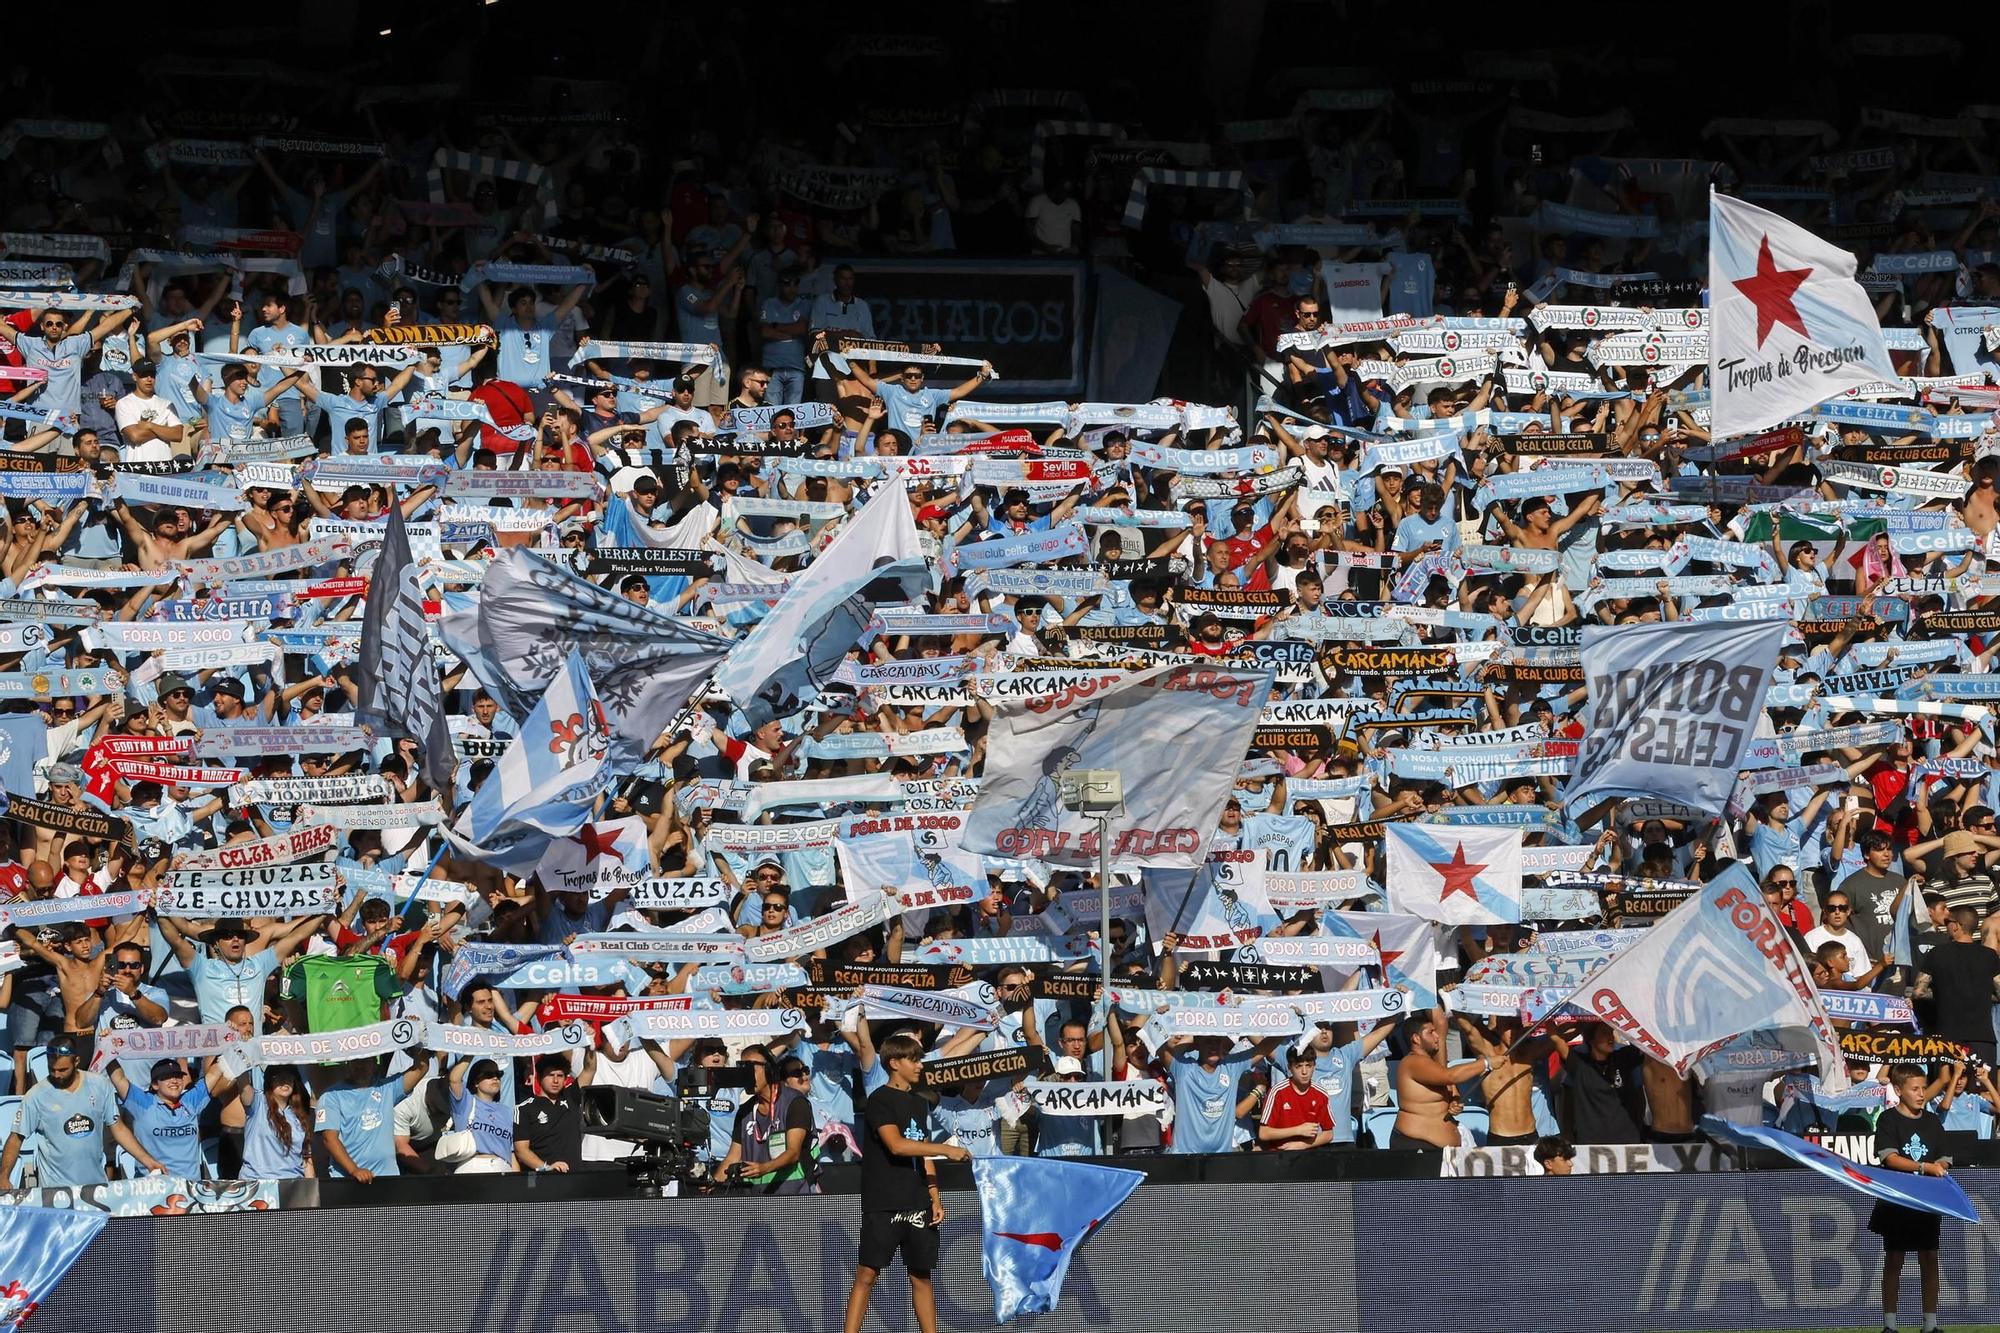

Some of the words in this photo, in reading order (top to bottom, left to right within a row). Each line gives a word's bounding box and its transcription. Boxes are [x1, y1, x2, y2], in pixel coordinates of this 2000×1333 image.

[1877, 254, 1954, 271] RCCelta
[1718, 358, 1773, 392] Tropas
[1778, 354, 1793, 375] de
[1793, 339, 1866, 374] Breogán
[1830, 404, 1855, 418] R.C.
[1857, 406, 1898, 421] CELTA
[1379, 443, 1396, 463] RC
[1399, 440, 1444, 460] CELTA
[1516, 440, 1540, 451] REAL
[1542, 439, 1565, 450] CLUB
[1567, 438, 1593, 450] CELTA
[1866, 449, 1892, 461] REAL
[1894, 449, 1922, 460] CLUB
[1924, 448, 1950, 460] CELTA
[10, 460, 43, 472] CELTA
[1043, 462, 1076, 472] Sevilla
[140, 481, 158, 493] REAL
[160, 484, 182, 498] CLUB
[183, 485, 208, 500] CELTA
[1899, 474, 1965, 492] CELESTE
[224, 547, 304, 576] CELTA
[598, 548, 640, 560] TERRA
[644, 550, 701, 561] CELESTE
[1511, 550, 1553, 566] ASPAS
[1881, 577, 1946, 595] CELTA
[1184, 589, 1212, 602] REAL
[1216, 591, 1245, 604] CLUB
[1247, 592, 1280, 604] CELTA
[218, 601, 272, 619] CELTA
[1694, 602, 1780, 621] RCCelta
[692, 621, 714, 632] Vigo
[1925, 617, 1950, 630] REAL
[1951, 616, 1976, 629] CLUB
[168, 630, 185, 642] DE
[193, 628, 231, 642] XOGO
[1081, 628, 1106, 639] REAL
[1109, 628, 1134, 638] CLUB
[1137, 626, 1165, 638] CELTA
[1334, 649, 1448, 669] CARCAMÄNS
[1516, 667, 1540, 680] REAL
[1542, 667, 1568, 680] CLUB
[1256, 733, 1285, 747] CLUB
[1287, 733, 1320, 747] CELTA
[1409, 753, 1438, 763] NOSA
[1441, 753, 1510, 764] RECONQUISTA
[117, 760, 154, 776] CONTRA
[158, 765, 188, 780] VENTO
[10, 803, 34, 822] REAL
[38, 813, 72, 828] CLUB
[75, 818, 108, 834] CELTA
[893, 817, 914, 832] DE
[917, 815, 961, 831] XOGO
[1458, 813, 1488, 825] R.C.
[1489, 811, 1532, 824] CELTA
[759, 829, 785, 843] DE
[1334, 826, 1360, 840] REAL
[1540, 851, 1558, 866] DE
[174, 863, 330, 887] LE-CHUZAS
[556, 870, 597, 888] Tropas
[601, 867, 612, 882] de
[1301, 879, 1316, 892] DE
[1320, 876, 1356, 891] XOGO
[176, 890, 321, 908] LE-CHUZAS
[916, 892, 936, 906] DE
[939, 885, 973, 902] VIGO
[1625, 900, 1654, 915] REAL
[745, 965, 800, 981] ASPAS
[835, 970, 865, 984] REAL
[1044, 981, 1072, 996] REAL
[1306, 1000, 1324, 1015] DE
[1328, 997, 1371, 1014] XOGO
[1820, 998, 1880, 1016] CELTA
[700, 1016, 718, 1029] DE
[727, 1014, 769, 1028] XOGO
[1223, 1013, 1242, 1027] DE
[1248, 1011, 1289, 1026] XOGO
[128, 1029, 219, 1048] CELTA
[312, 1039, 331, 1052] DE
[337, 1032, 381, 1051] XOGO
[489, 1035, 507, 1047] DE
[513, 1034, 552, 1048] XOGO
[926, 1070, 960, 1086] REAL
[960, 1064, 990, 1080] CLUB
[993, 1057, 1026, 1075] CELTA
[1037, 1086, 1165, 1110] CARCAMÄNS
